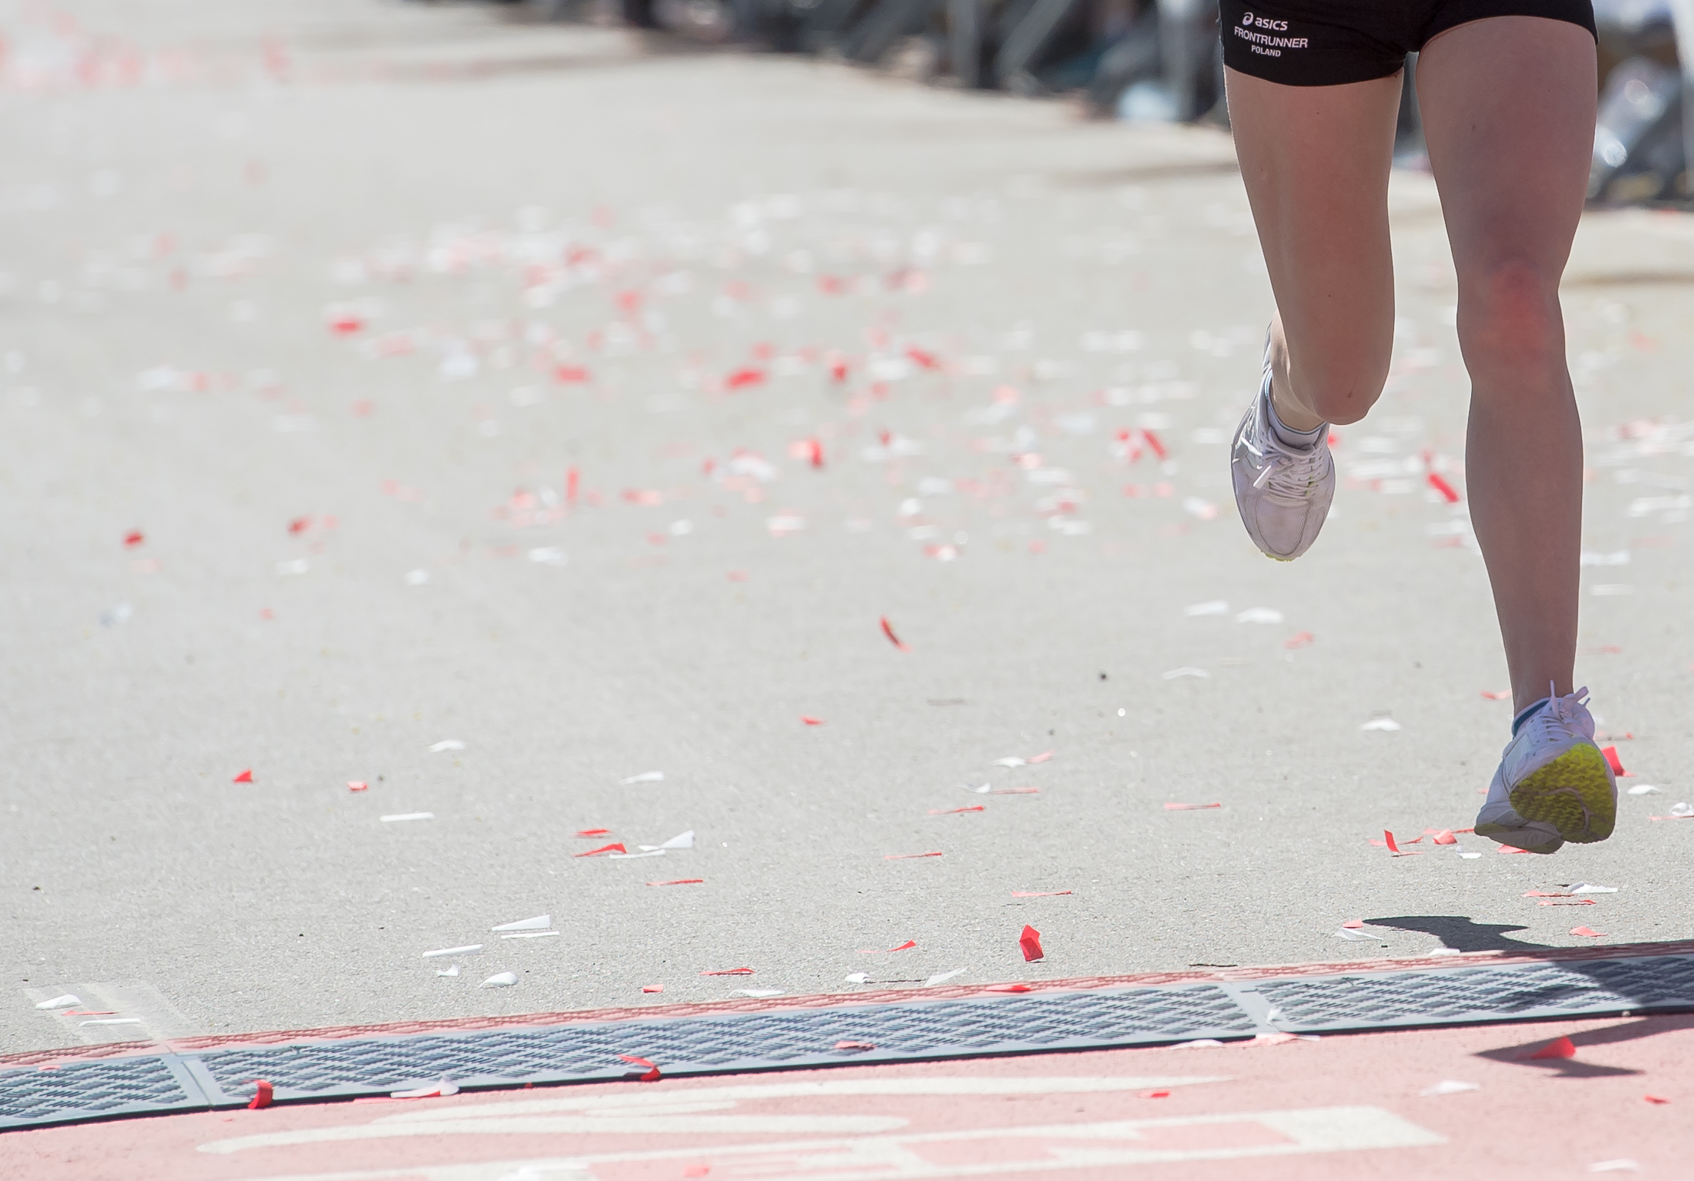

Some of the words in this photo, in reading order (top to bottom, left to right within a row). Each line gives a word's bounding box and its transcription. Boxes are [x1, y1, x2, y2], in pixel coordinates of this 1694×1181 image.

[1255, 17, 1288, 31] asics
[1234, 25, 1308, 48] FRONTRUNNER
[1251, 45, 1281, 57] POLAND
